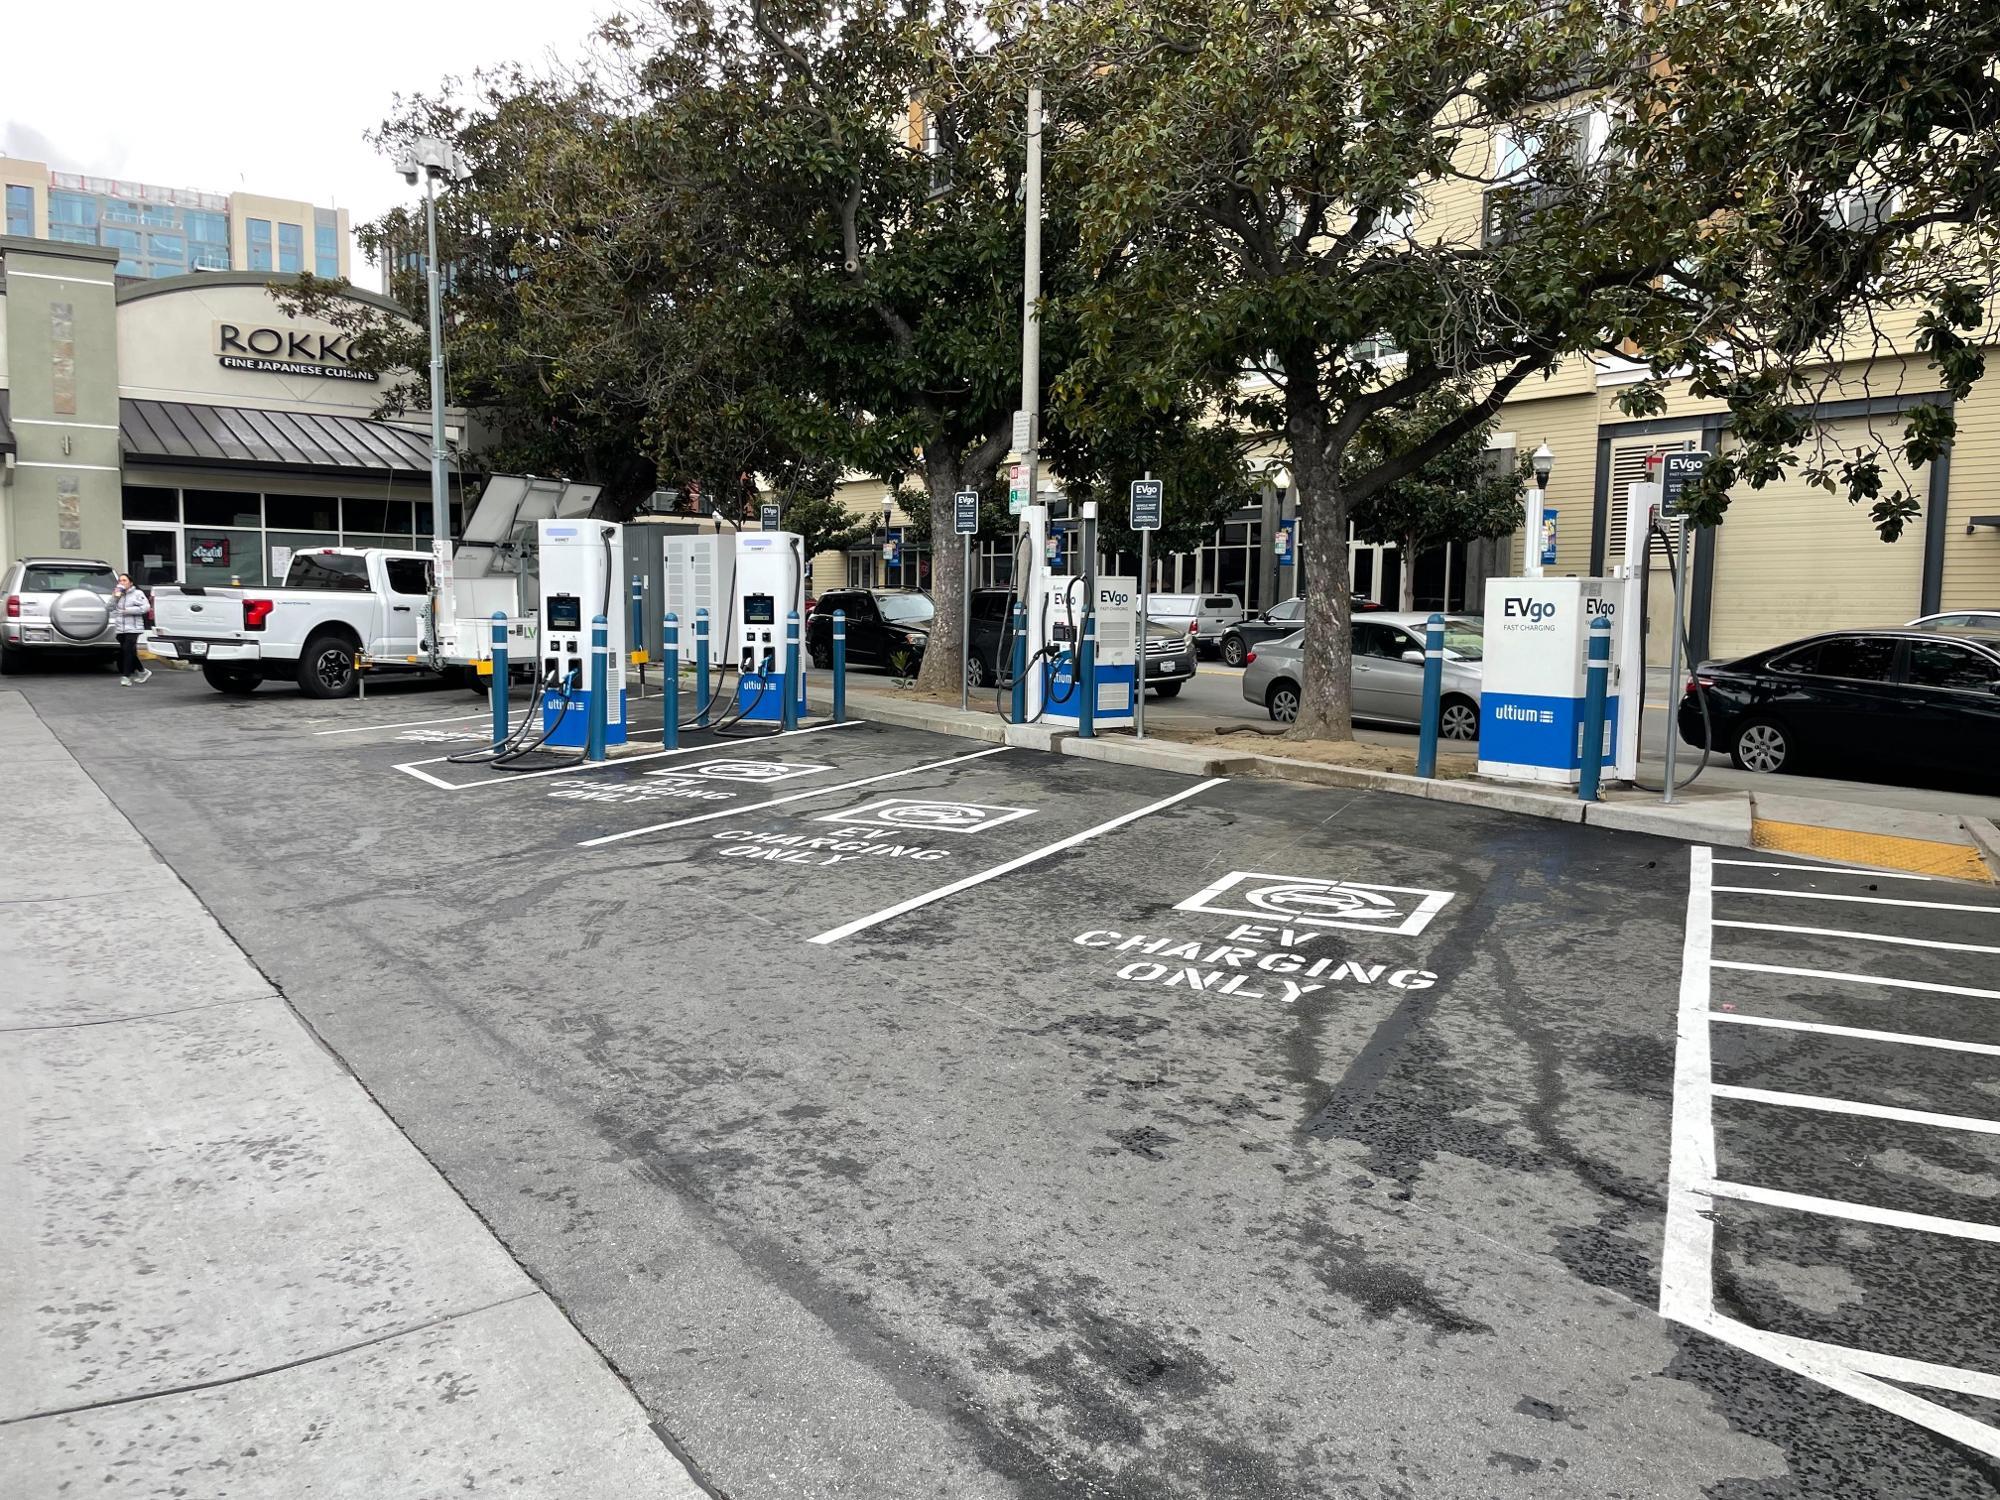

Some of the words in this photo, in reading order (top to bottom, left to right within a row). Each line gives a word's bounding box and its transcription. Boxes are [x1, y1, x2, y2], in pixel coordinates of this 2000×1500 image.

[224, 357, 254, 369] FINE
[256, 361, 323, 375] JAPANESE
[325, 367, 375, 381] CUISINE
[1670, 459, 1703, 472] EVgo
[1136, 485, 1158, 496] EVgo
[1100, 590, 1129, 605] EVgo
[1503, 597, 1556, 623] EVgo
[1503, 624, 1519, 632] FAST
[1519, 624, 1556, 632] CHARGING
[1495, 704, 1538, 722] ultium
[828, 827, 902, 839] EV
[712, 830, 950, 860] CHARGING
[718, 845, 862, 866] ONLY
[1225, 924, 1321, 948] EV
[1073, 930, 1440, 990] CHARGING
[1116, 962, 1326, 1002] ONLY
